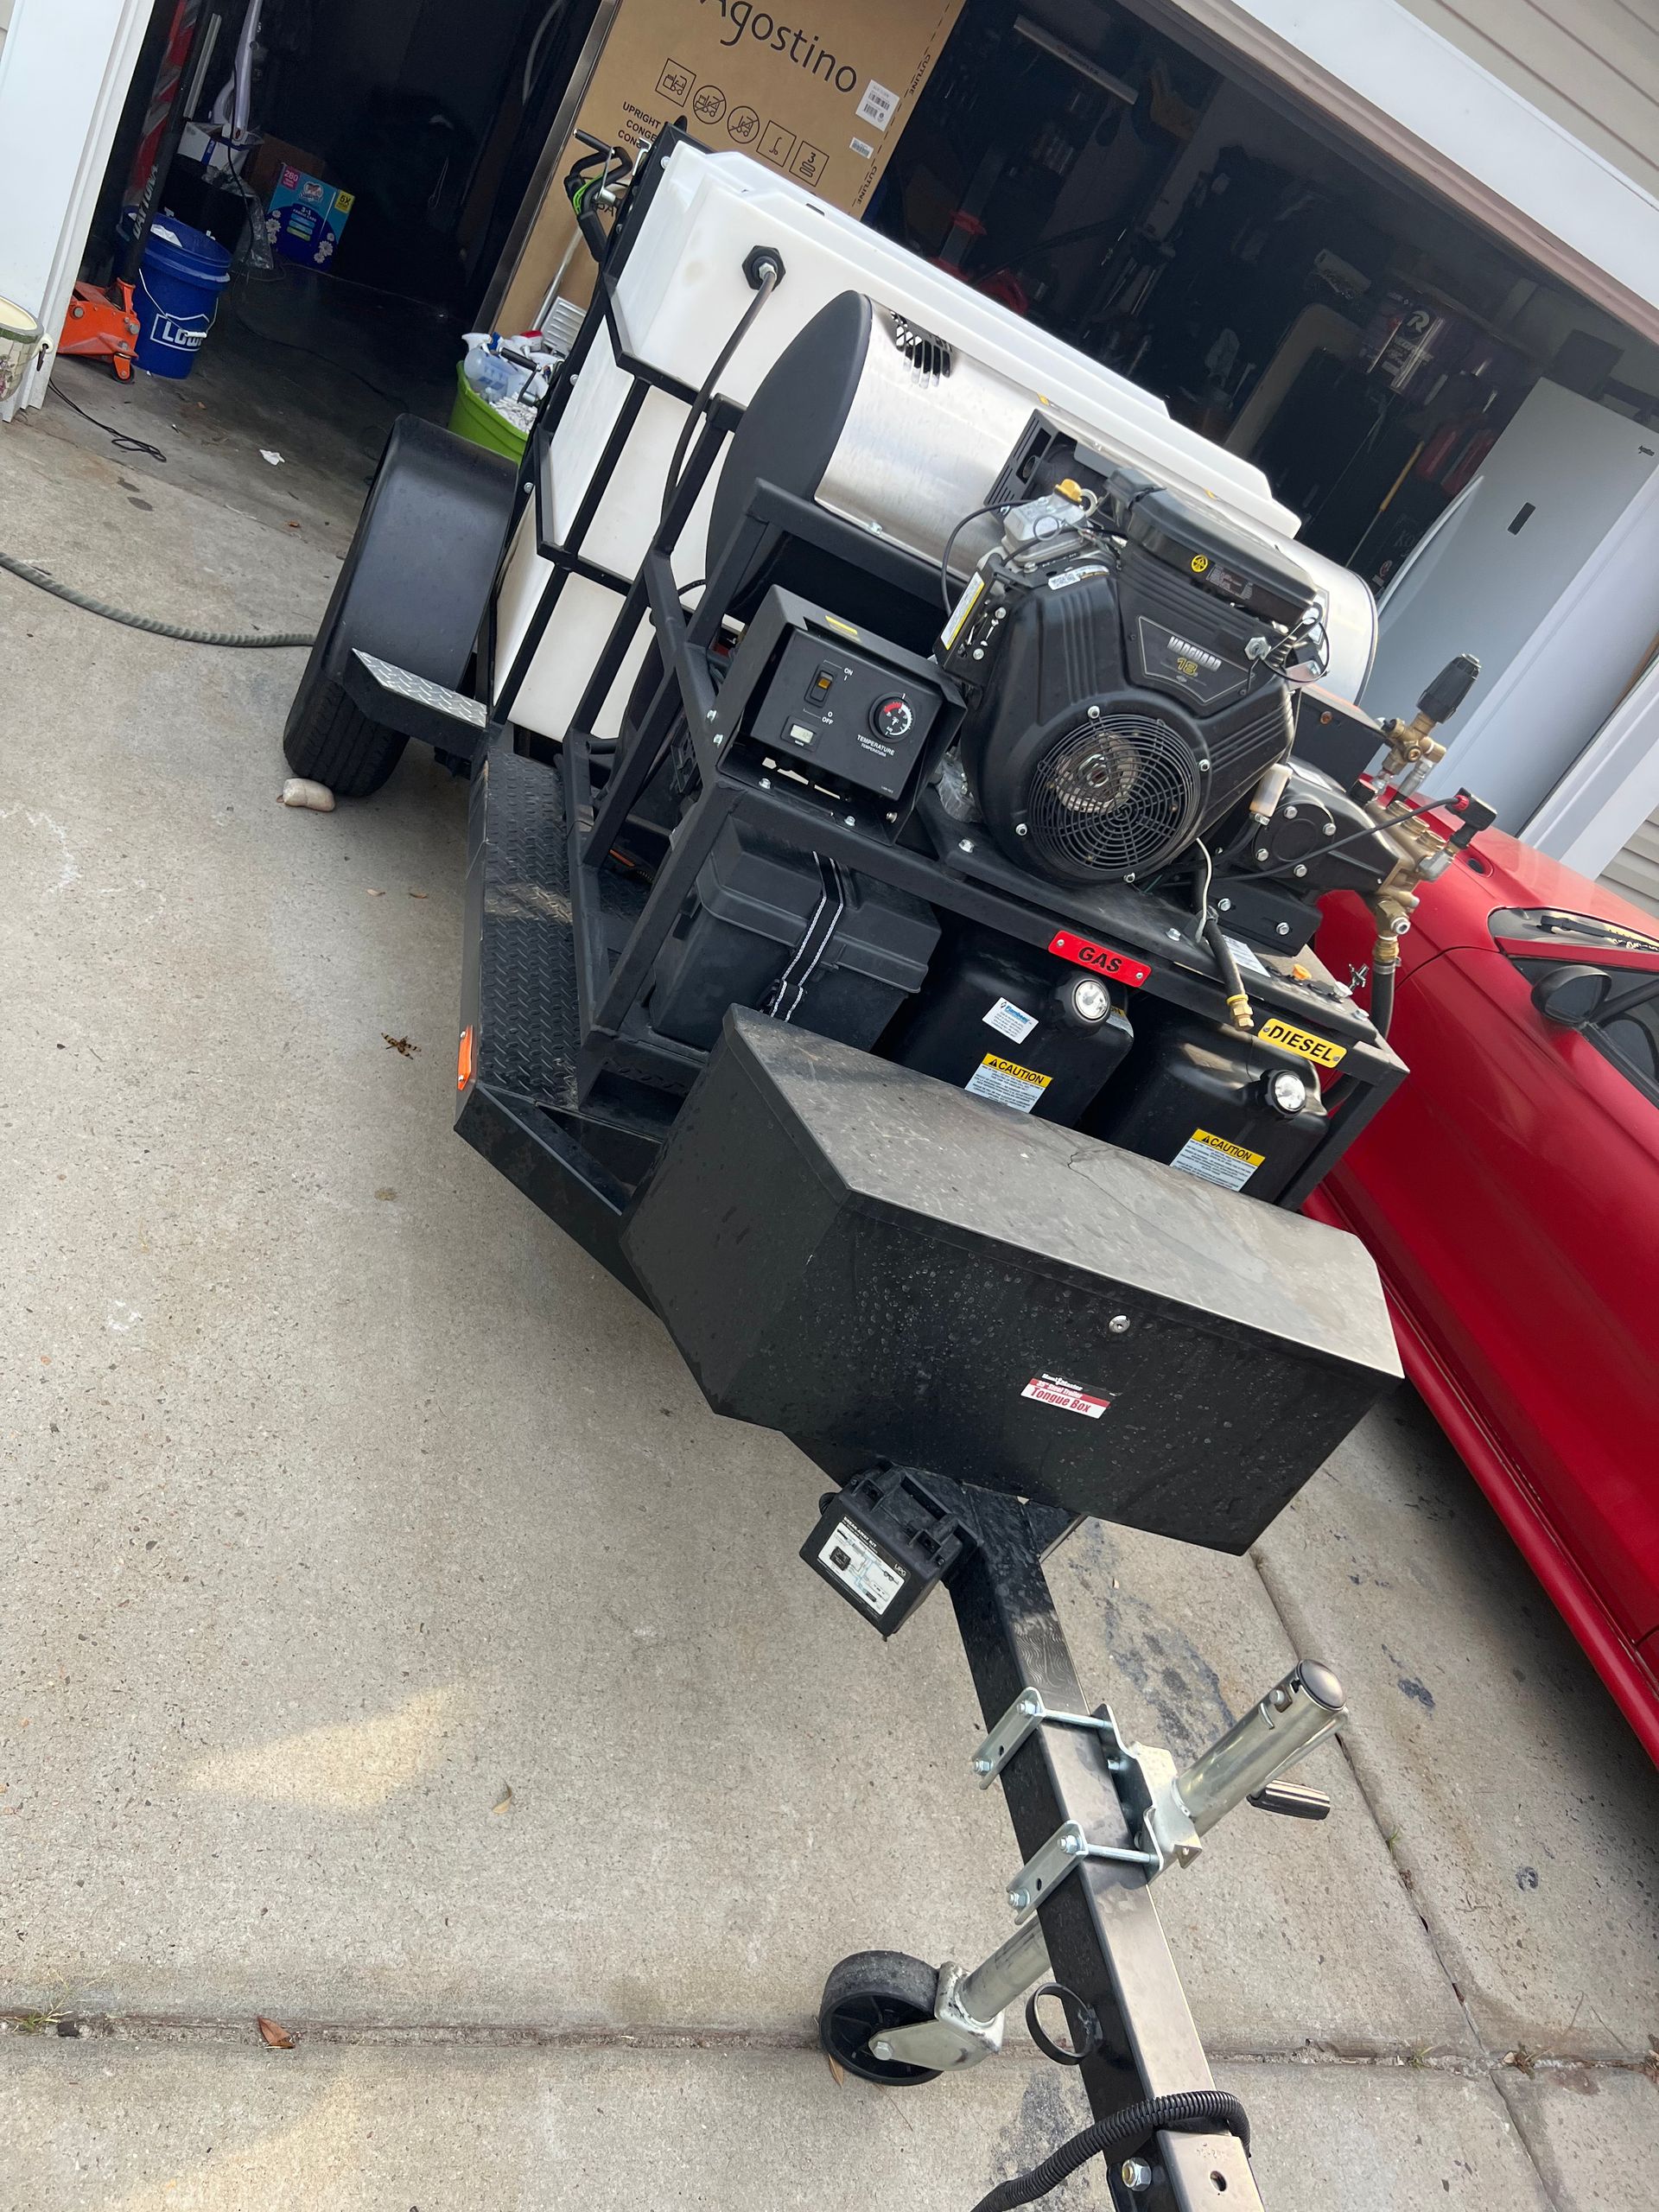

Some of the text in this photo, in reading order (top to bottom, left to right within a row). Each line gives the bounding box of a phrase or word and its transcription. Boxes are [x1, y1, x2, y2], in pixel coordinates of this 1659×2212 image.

[622, 101, 661, 129] UPRIGHT
[844, 667, 853, 676] ON
[1177, 657, 1198, 676] 18
[822, 716, 834, 725] OFF
[856, 734, 895, 756] TEMPERATURE
[1077, 946, 1122, 973] GAS
[1268, 1025, 1333, 1063] DIESEL
[998, 1061, 1045, 1084] CAUTION
[1210, 1137, 1253, 1160] CAUTION
[1031, 1387, 1091, 1413] Tongue Box
[868, 1539, 877, 1548] KIT
